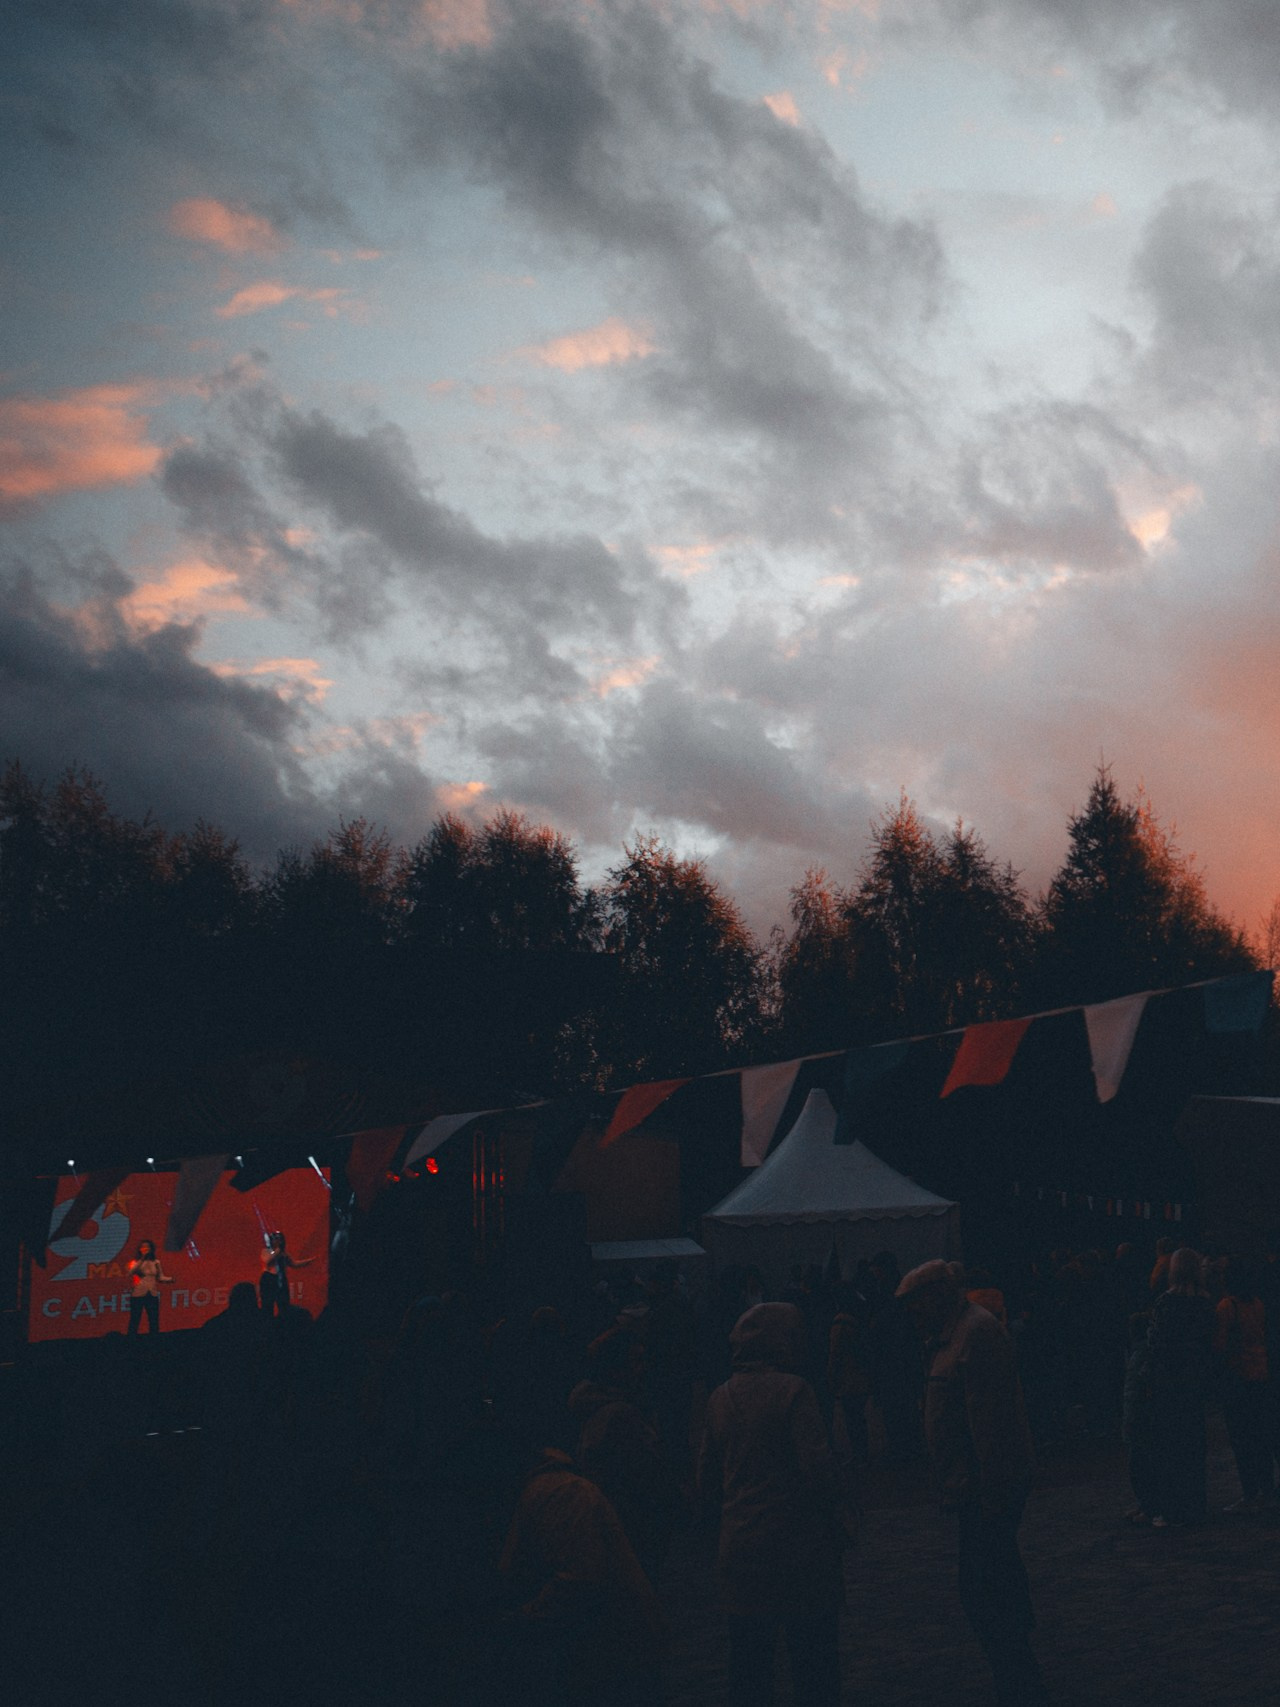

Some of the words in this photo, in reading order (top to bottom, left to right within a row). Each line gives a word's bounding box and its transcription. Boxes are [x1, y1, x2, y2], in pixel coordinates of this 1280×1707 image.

[87, 1262, 125, 1280] МА
[42, 1297, 62, 1318] С
[71, 1289, 160, 1320] ДНЁ
